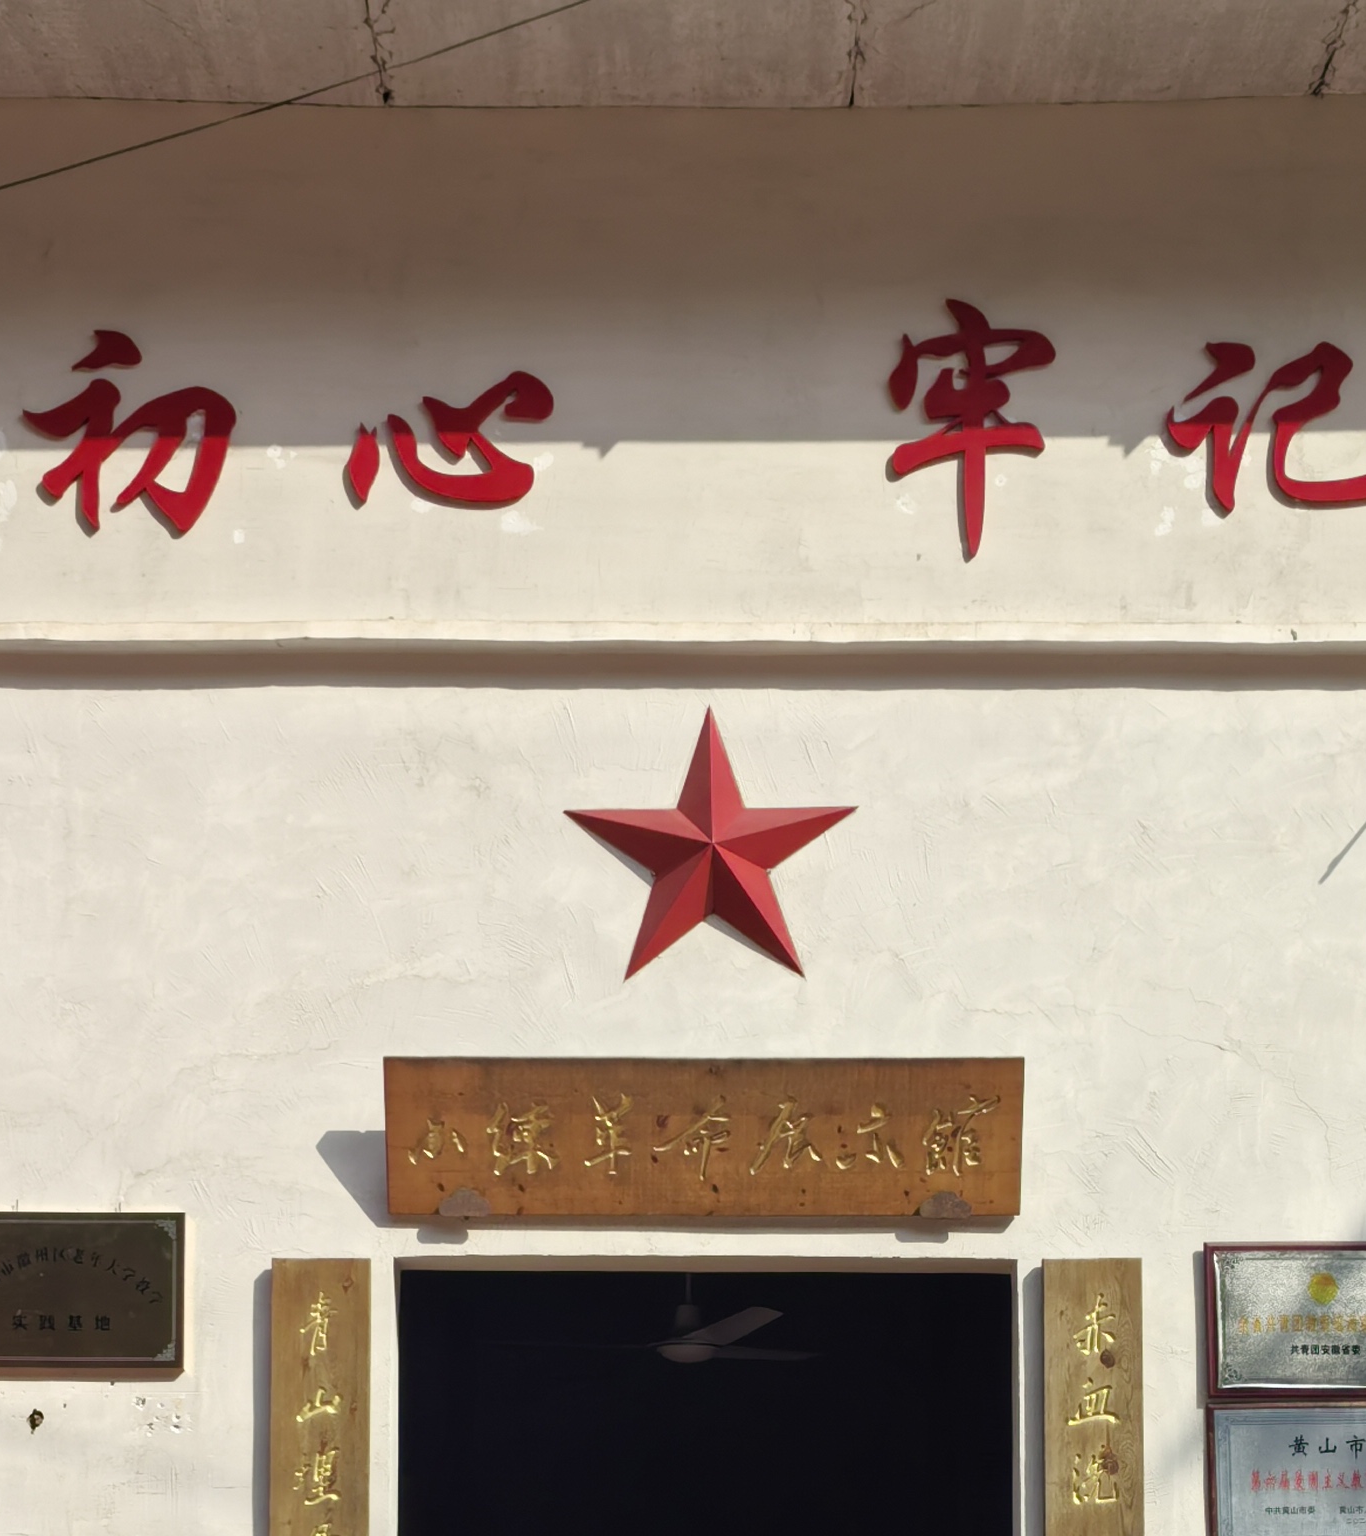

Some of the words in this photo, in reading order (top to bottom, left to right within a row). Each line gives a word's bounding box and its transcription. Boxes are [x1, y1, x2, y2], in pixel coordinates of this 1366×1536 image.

[11, 1314, 111, 1331] 实践基地
[1288, 1434, 1366, 1460] 黄山市
[1264, 1505, 1316, 1516] 中共黄山市委
